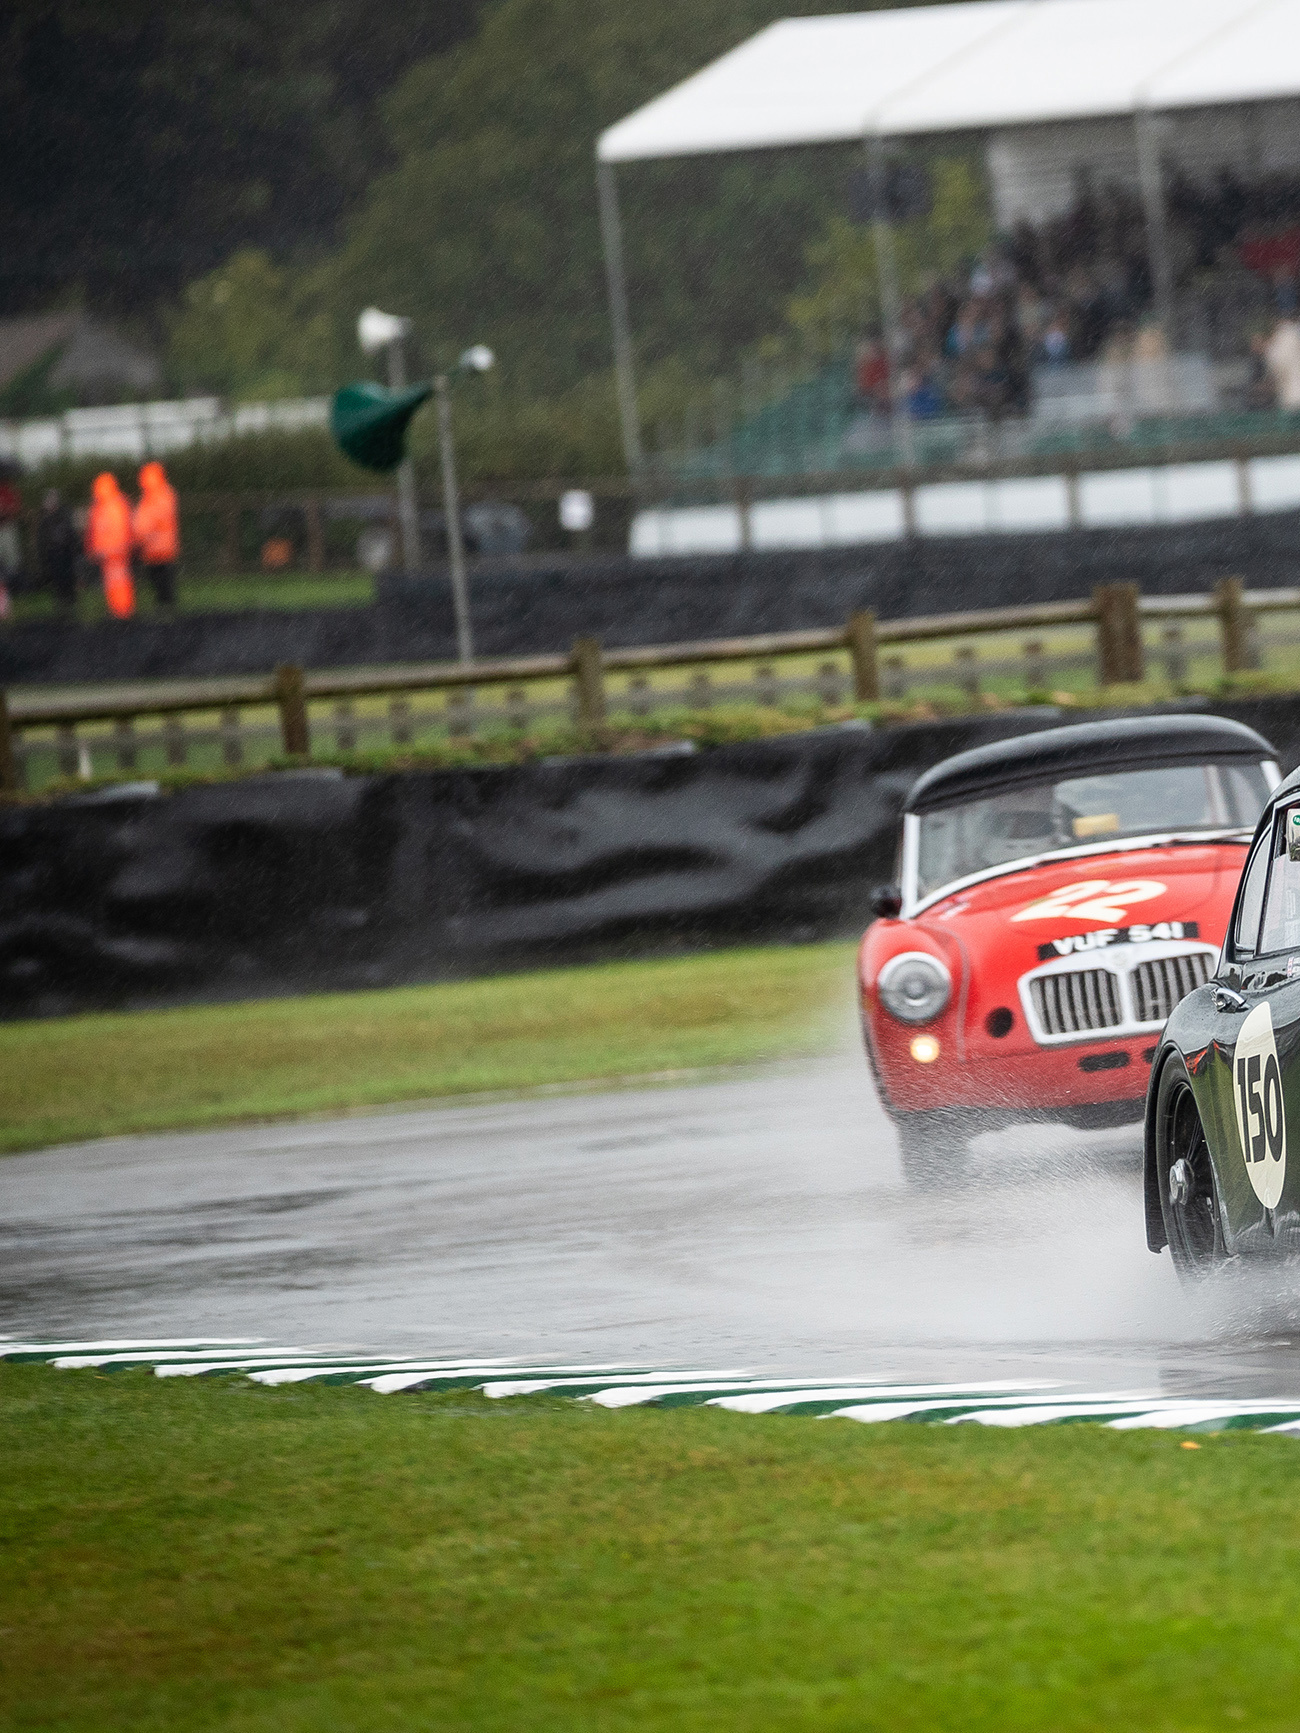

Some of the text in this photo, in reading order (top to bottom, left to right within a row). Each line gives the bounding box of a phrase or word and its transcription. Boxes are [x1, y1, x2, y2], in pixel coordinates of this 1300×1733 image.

[1009, 879, 1168, 923] 22
[1051, 921, 1185, 956] VUF 541
[1237, 1053, 1284, 1163] 150
